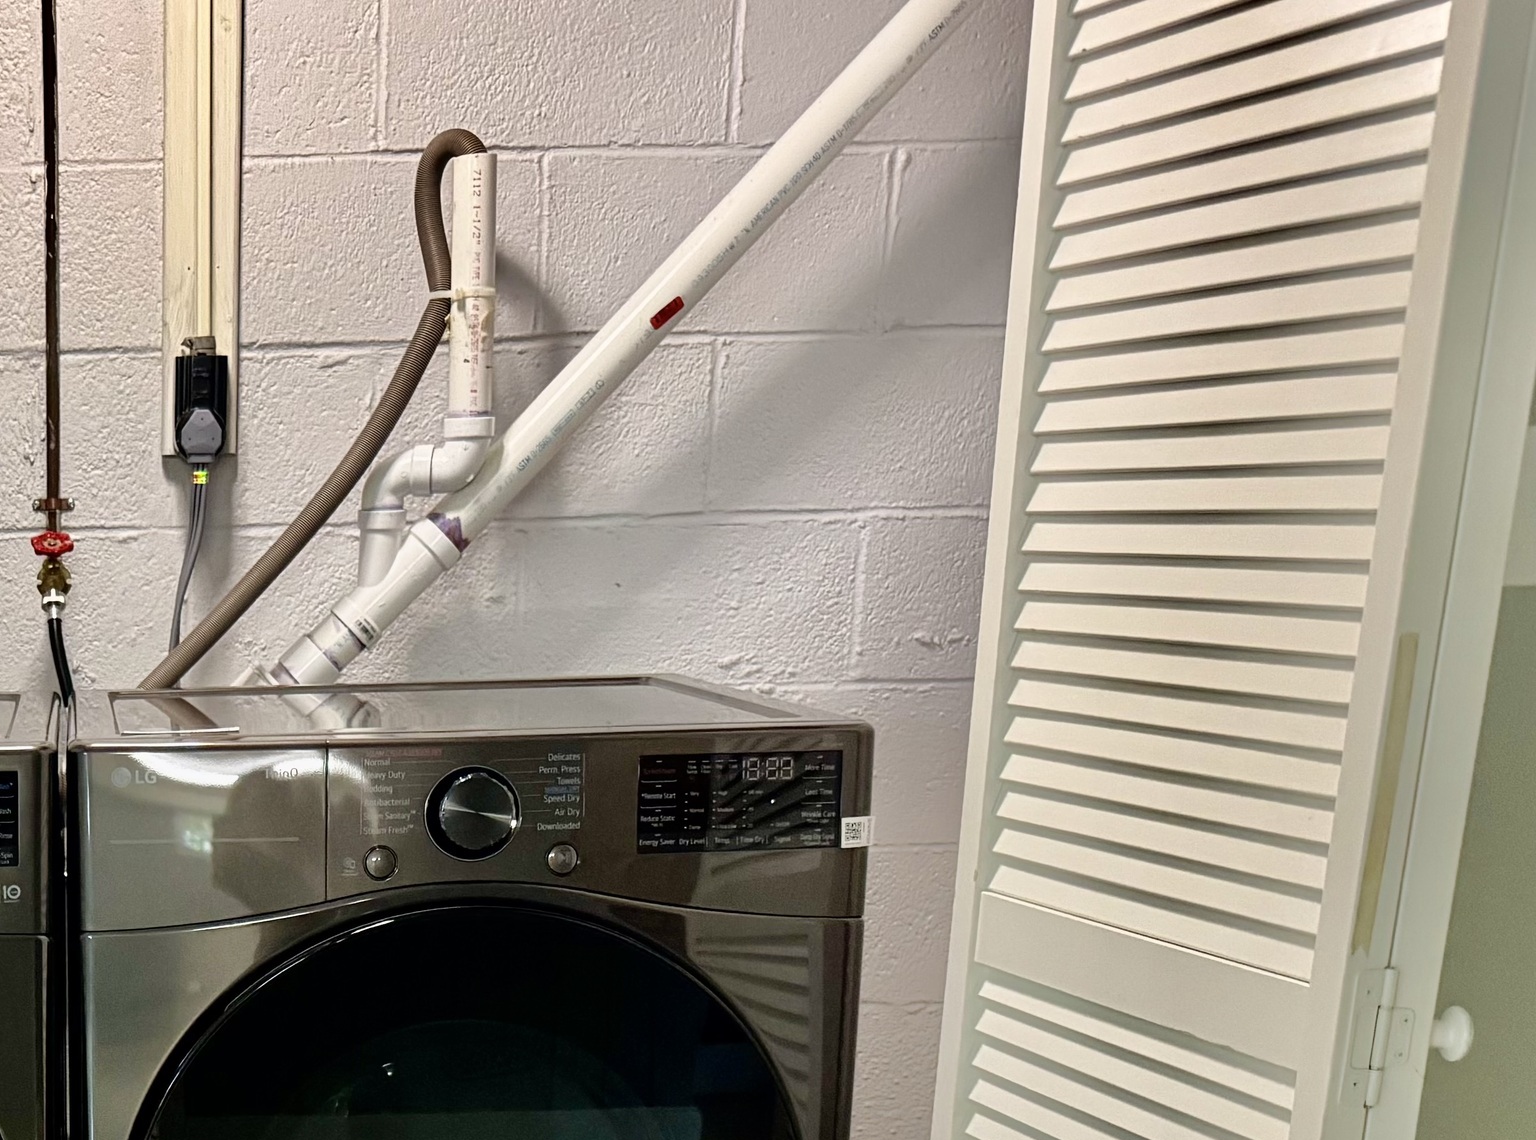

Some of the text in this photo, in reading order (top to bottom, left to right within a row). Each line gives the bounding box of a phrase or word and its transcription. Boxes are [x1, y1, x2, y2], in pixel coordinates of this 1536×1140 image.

[820, 135, 837, 154] ASTM
[516, 455, 531, 472] ASTM
[548, 753, 581, 761] Delicates
[364, 758, 391, 767] Normal
[821, 763, 836, 771] Time
[561, 765, 581, 773] Press
[135, 770, 157, 784] LG
[387, 771, 406, 780] Duty
[557, 777, 581, 785] Towels
[544, 794, 580, 803] Speed Dry
[554, 808, 580, 817] Air Dry
[537, 821, 581, 831] Downloaded
[639, 838, 659, 847] Energy
[678, 838, 689, 846] Dry
